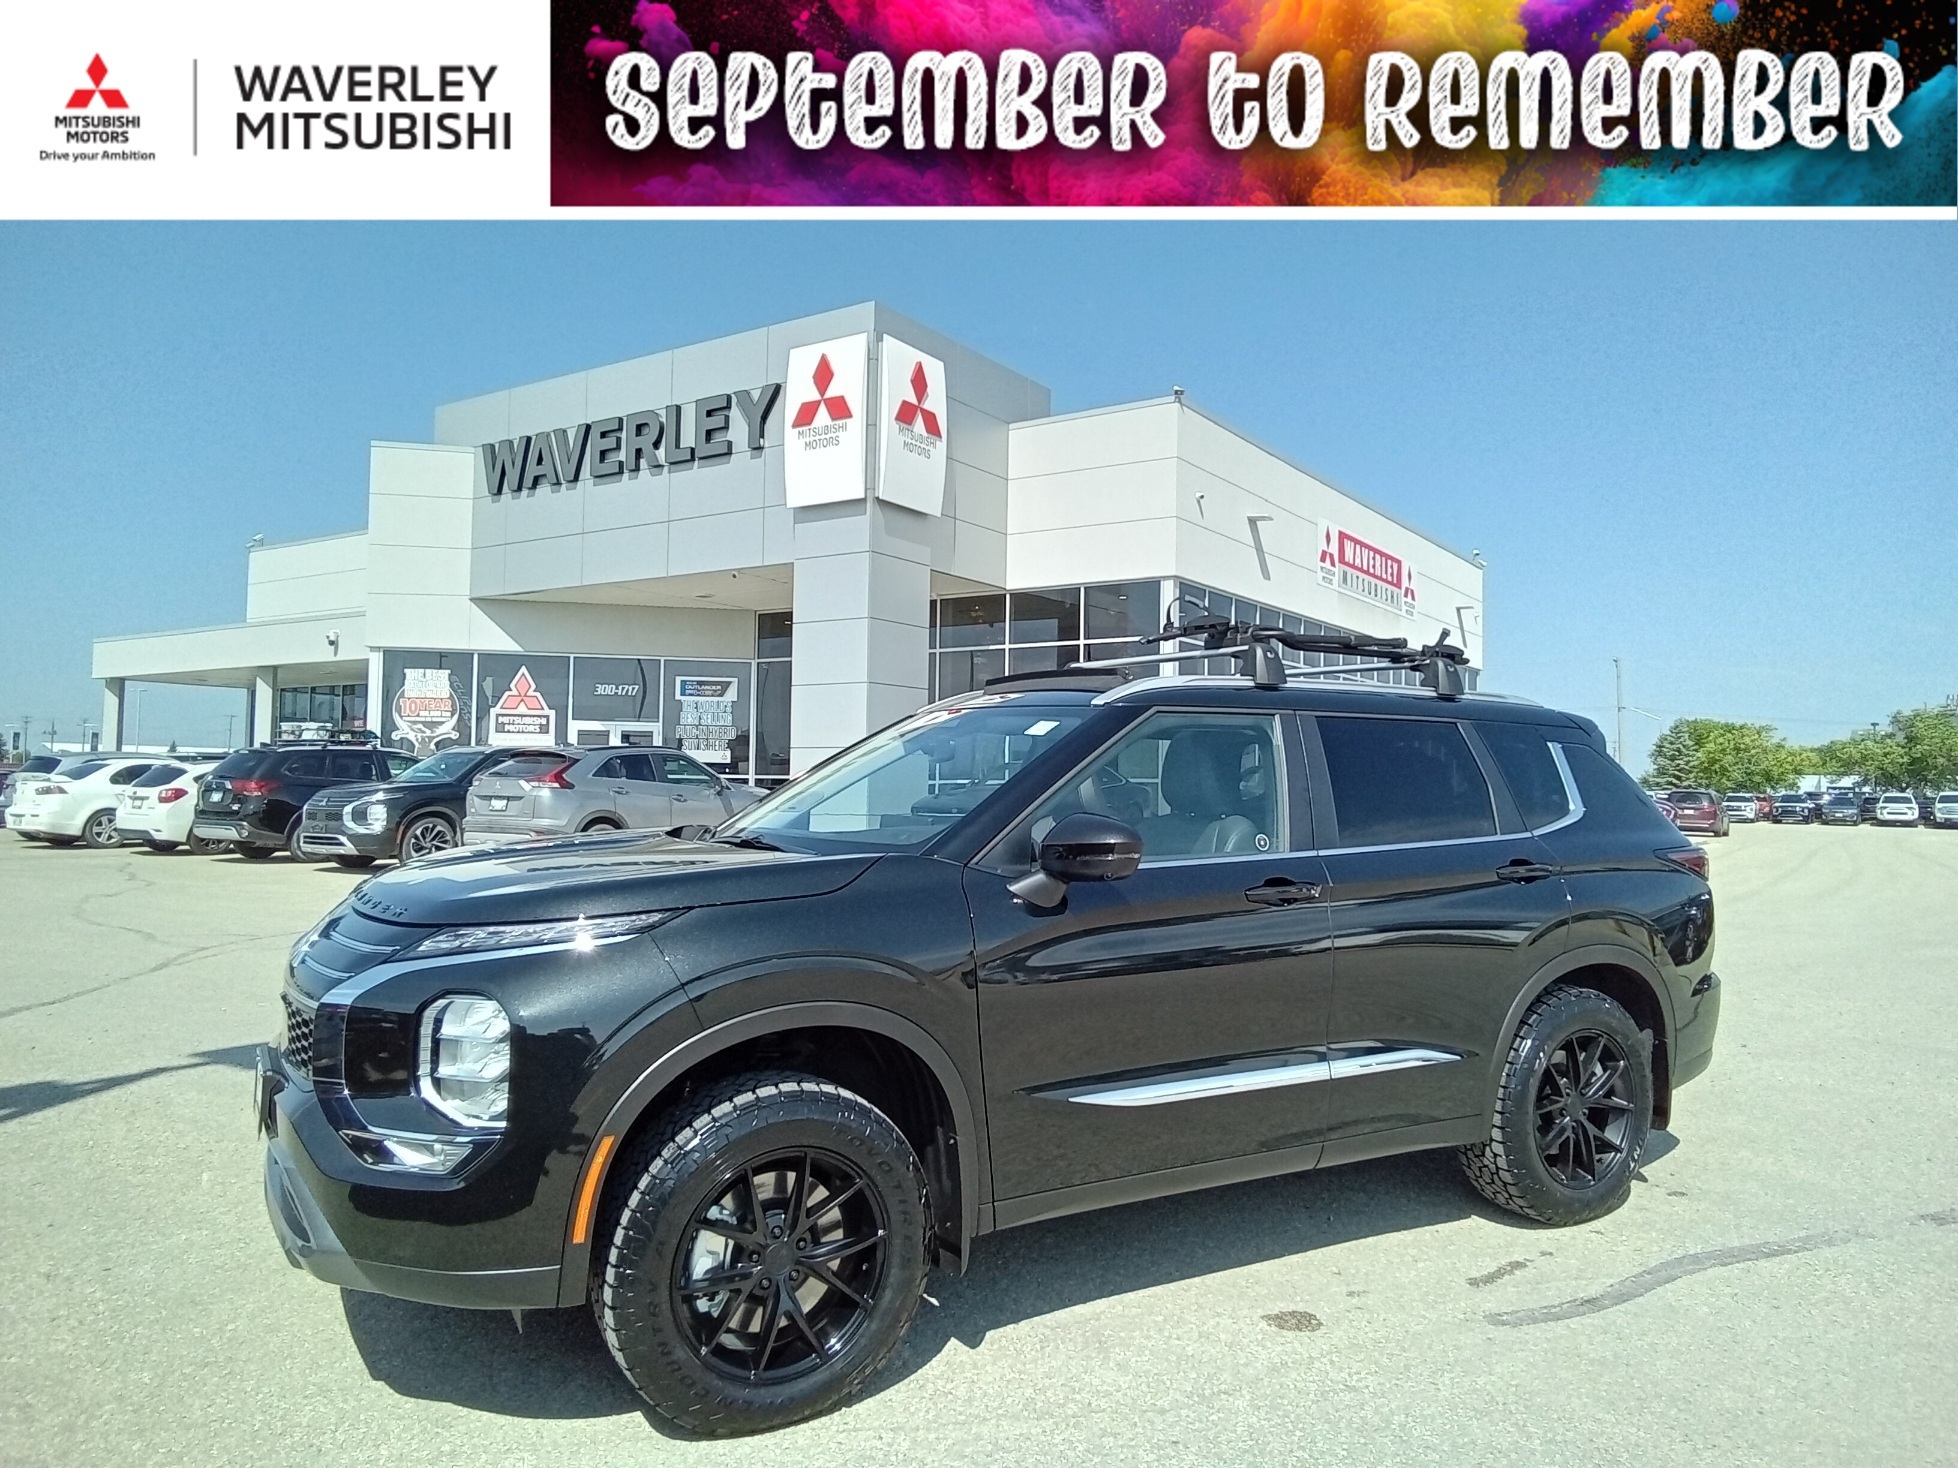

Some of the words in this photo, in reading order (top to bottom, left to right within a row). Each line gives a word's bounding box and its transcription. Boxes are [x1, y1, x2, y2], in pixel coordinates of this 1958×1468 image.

[797, 422, 848, 440] MITSUBISHI
[897, 424, 938, 451] MITSUBISHI
[482, 383, 781, 496] WAVERLEY
[804, 436, 840, 451] MOTORS
[903, 439, 931, 460] MOTORS
[1343, 538, 1399, 584] WAVERLEY
[1342, 569, 1399, 606] MITSUBISHI
[405, 669, 424, 680] THE
[425, 669, 450, 681] BEST
[593, 683, 639, 696] 300-1717
[400, 698, 419, 716] 10
[419, 699, 452, 710] YEAR
[681, 700, 697, 712] THE
[697, 700, 732, 712] WORLD'S
[497, 716, 547, 725] MITSUBISHI
[680, 712, 700, 725] BEST
[700, 713, 732, 725] SELLING
[504, 724, 541, 733] MOTORS
[676, 726, 707, 738] PLUG-IN
[708, 726, 736, 739] HYBRID
[682, 739, 698, 751] SUV
[699, 740, 707, 751] IS
